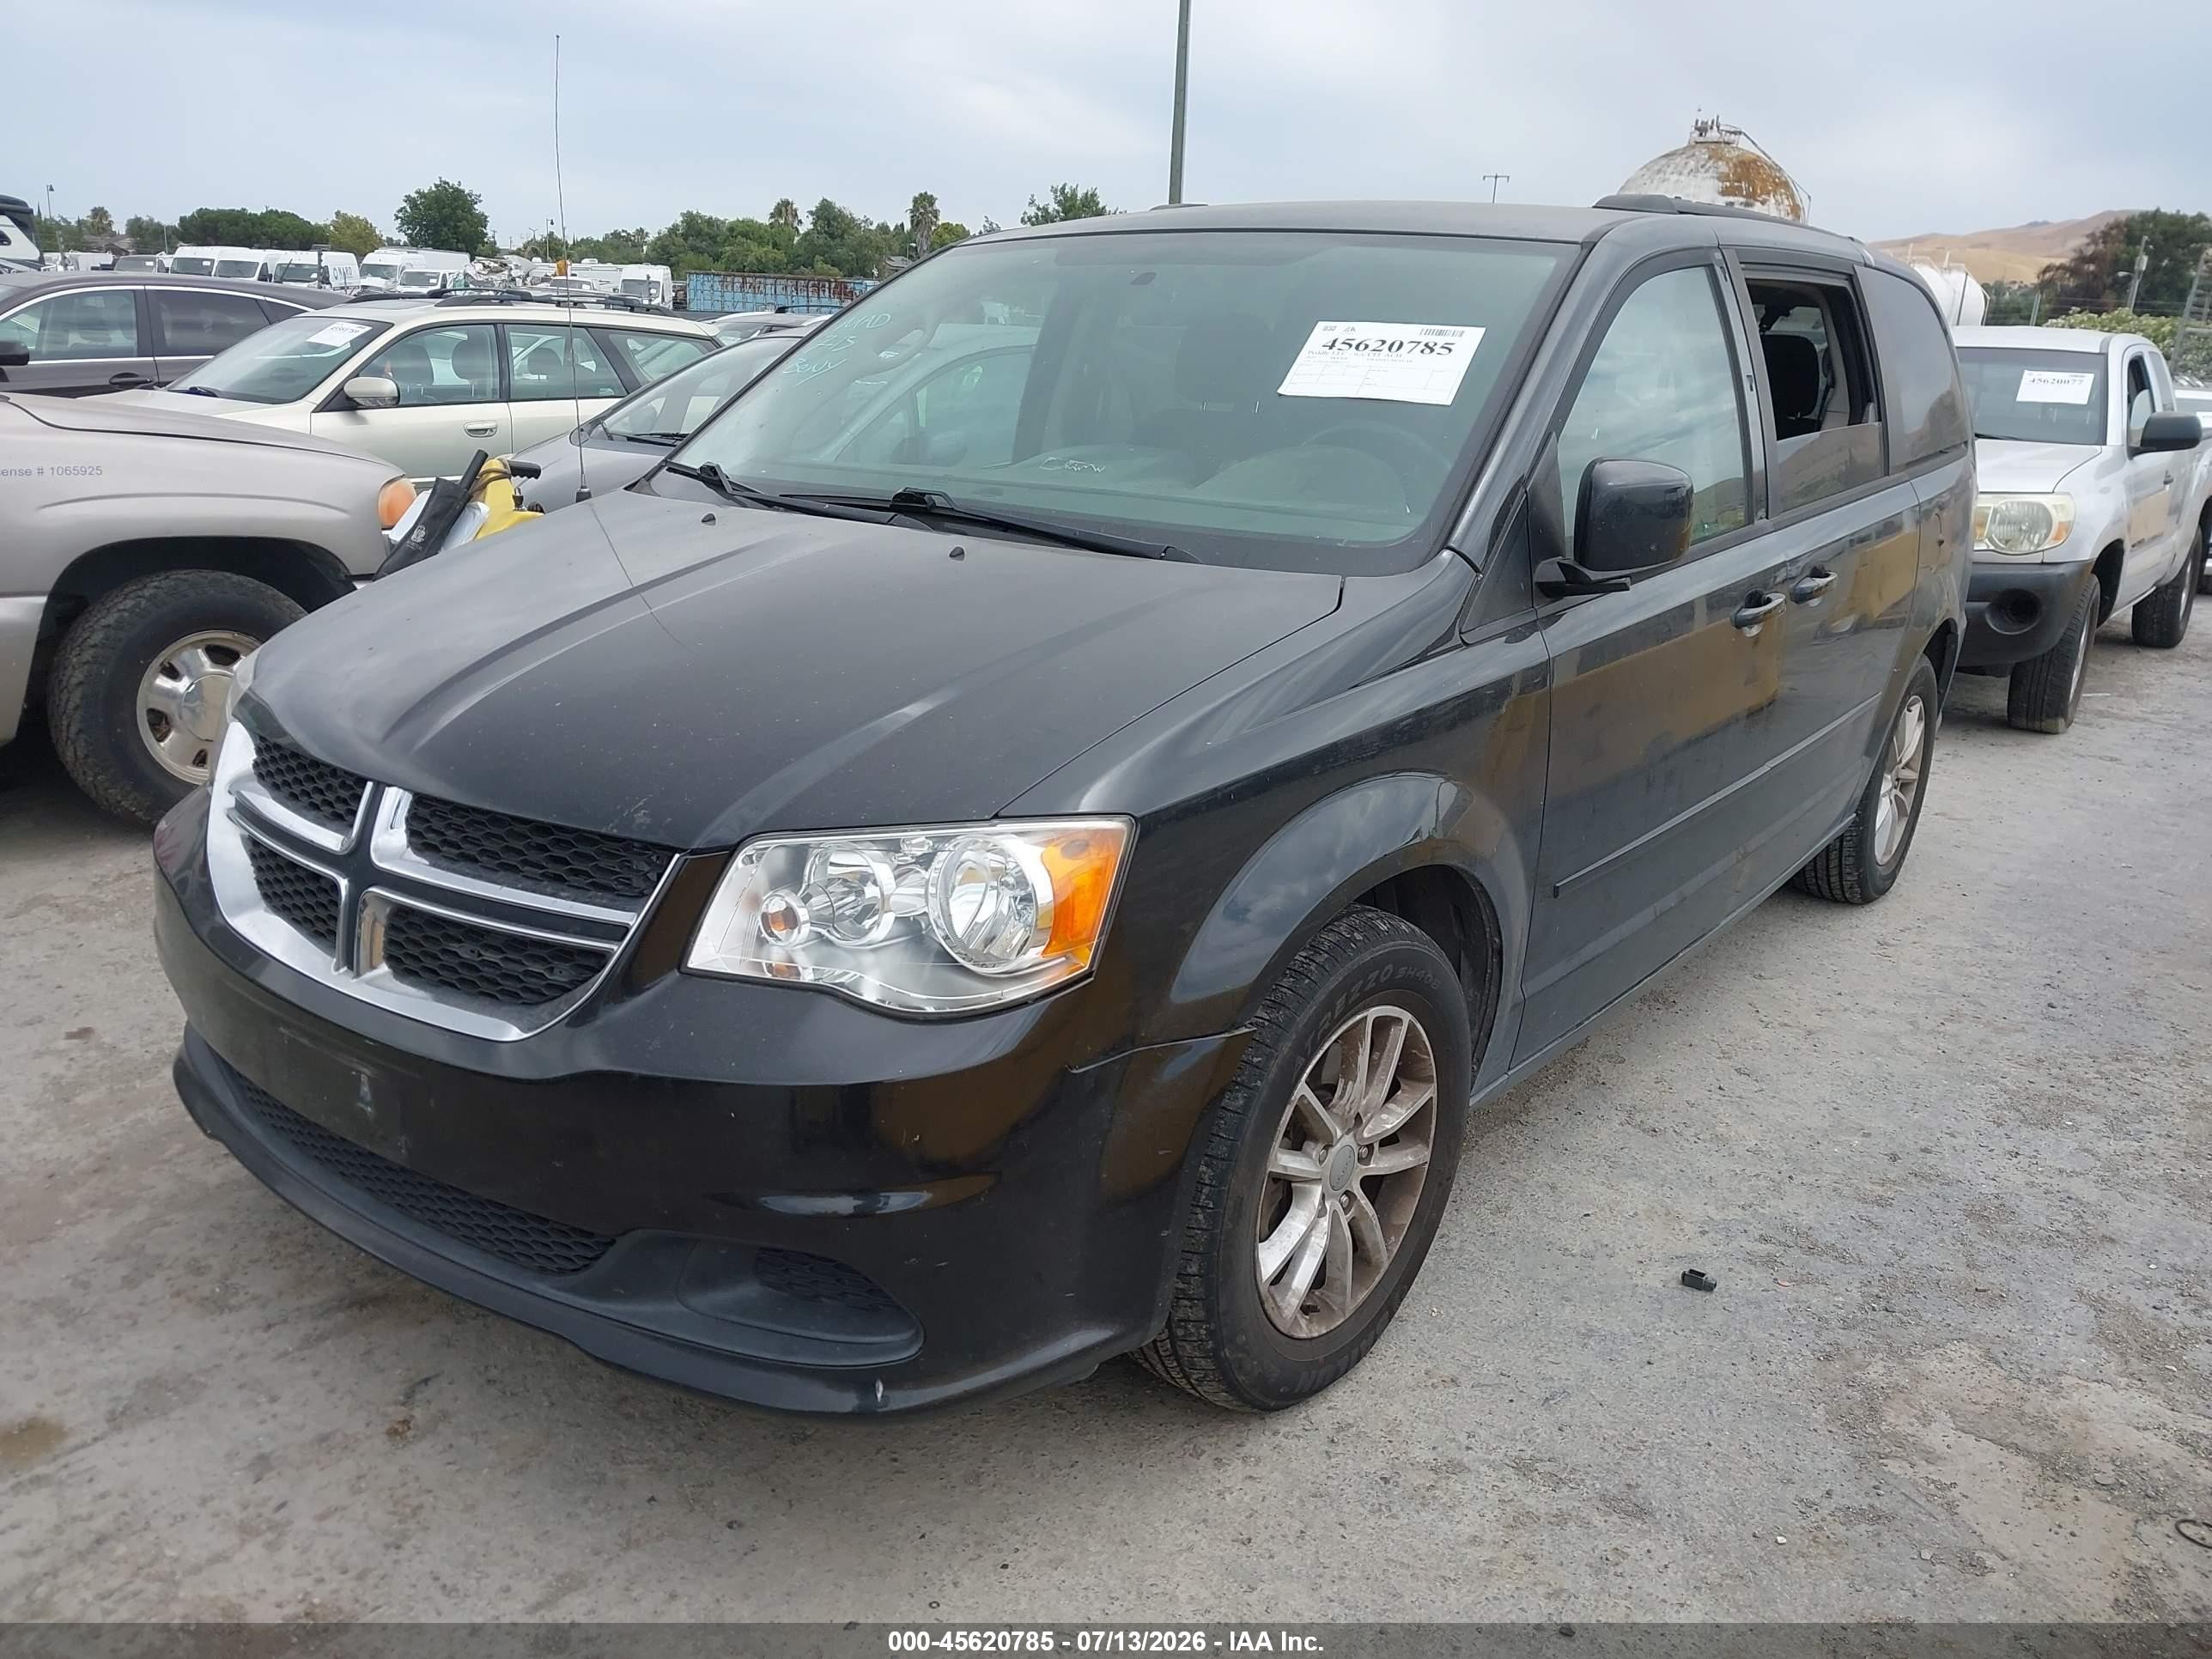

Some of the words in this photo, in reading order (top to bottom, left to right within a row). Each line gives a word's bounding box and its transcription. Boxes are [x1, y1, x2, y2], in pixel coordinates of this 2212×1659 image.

[1322, 337, 1456, 356] 45620785
[0, 466, 33, 477] ense
[37, 466, 45, 477] #
[50, 465, 103, 477] 1065925
